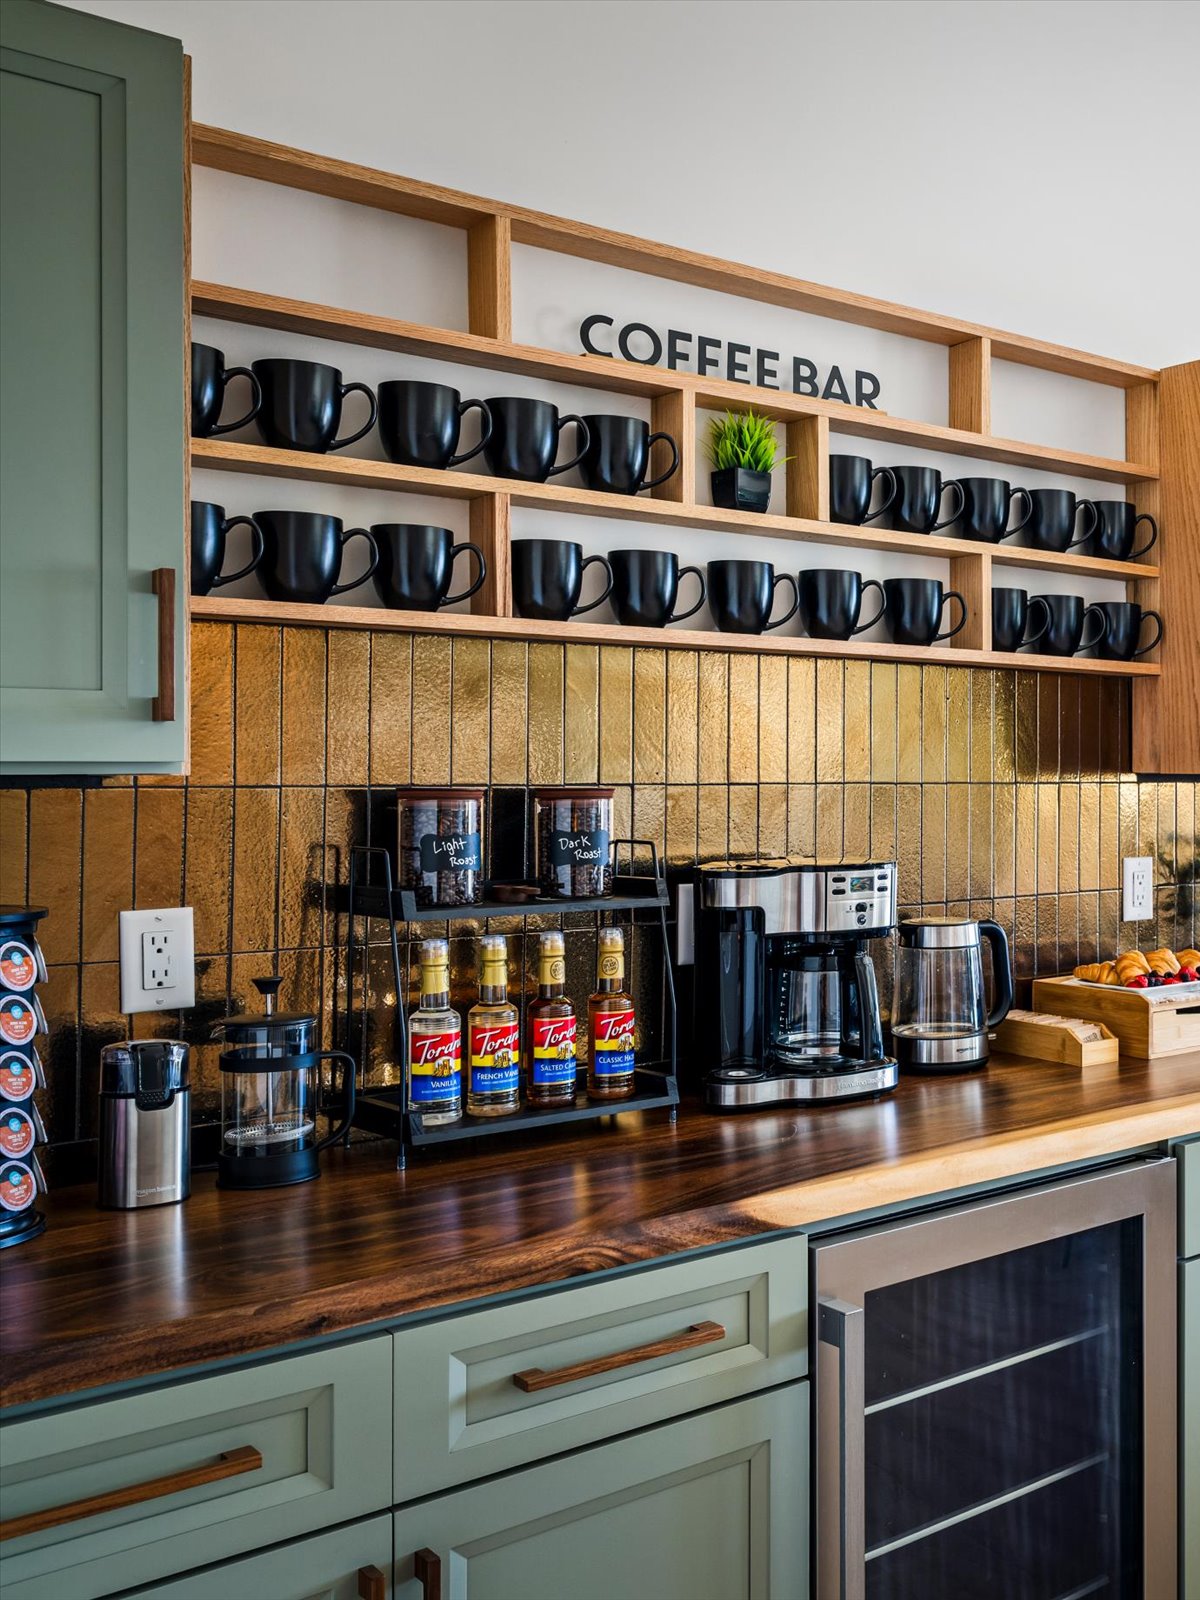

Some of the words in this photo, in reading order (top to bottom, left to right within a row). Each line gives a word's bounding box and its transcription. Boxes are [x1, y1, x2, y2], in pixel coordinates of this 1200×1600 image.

[579, 314, 780, 391] COFFEE
[792, 356, 881, 409] BAR
[433, 837, 467, 855] Light
[573, 847, 602, 860] Roast
[449, 854, 478, 867] Roast
[598, 1056, 623, 1064] CLASSIC
[540, 1063, 564, 1072] SALTED
[477, 1072, 504, 1080] FRENCH
[431, 1079, 457, 1088] VANILLA
